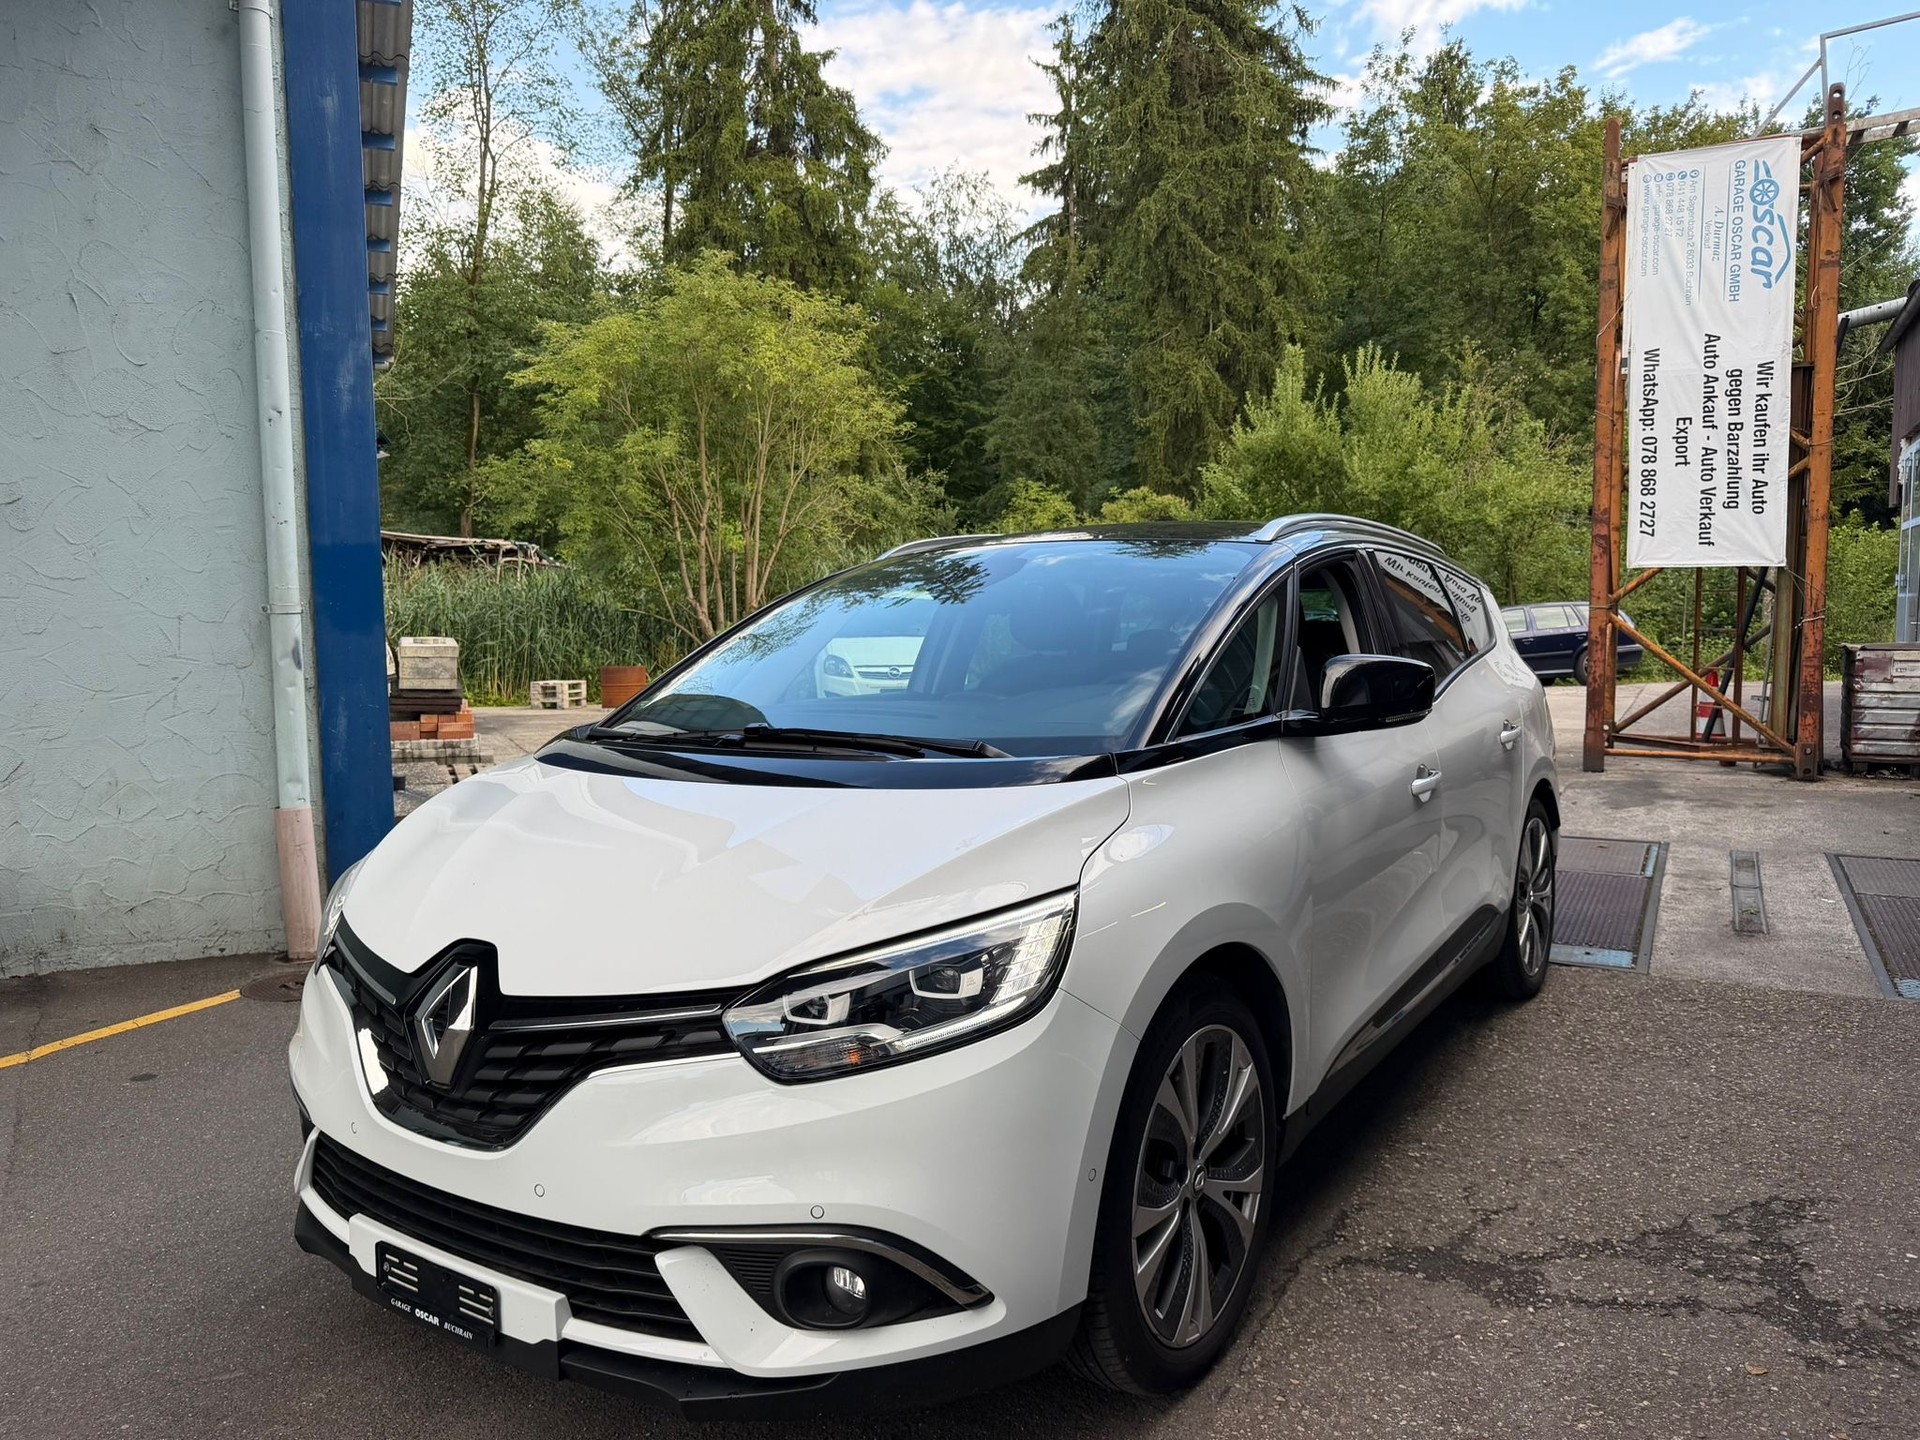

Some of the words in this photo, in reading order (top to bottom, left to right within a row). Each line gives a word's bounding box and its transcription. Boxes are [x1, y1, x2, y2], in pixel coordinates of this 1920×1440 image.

[1665, 182, 1674, 197] 078
[1689, 180, 1698, 194] Am
[1732, 159, 1747, 213] GARAGE
[1665, 199, 1674, 214] 868
[1665, 216, 1673, 226] 27
[1675, 216, 1685, 226] 15
[1676, 198, 1685, 214] 448
[1714, 205, 1725, 218] A.
[1664, 227, 1673, 238] 27
[1675, 226, 1684, 238] 72
[1711, 220, 1724, 262] Durmaz
[1730, 216, 1744, 261] OSCAR
[1686, 250, 1695, 272] 6033
[1728, 264, 1741, 302] GMBH
[1703, 333, 1721, 370] Auto
[1639, 347, 1660, 432] WhatsApp:
[1724, 368, 1744, 417] gegen
[1756, 360, 1775, 389] Wir
[1702, 373, 1719, 430] Ankauf
[1753, 392, 1773, 448] kaufen
[1641, 436, 1658, 465] 078
[1672, 416, 1692, 467] Export
[1701, 446, 1718, 482] Auto
[1722, 421, 1744, 510] Barzahlung
[1752, 451, 1770, 475] ihr
[1640, 468, 1657, 497] 868
[1751, 478, 1769, 515] Auto
[1639, 501, 1656, 538] 2727
[1698, 486, 1717, 547] Verkauf
[390, 1297, 411, 1313] GARAGE
[414, 1308, 440, 1326] OSCAR
[443, 1321, 474, 1340] BUCHRAIN
